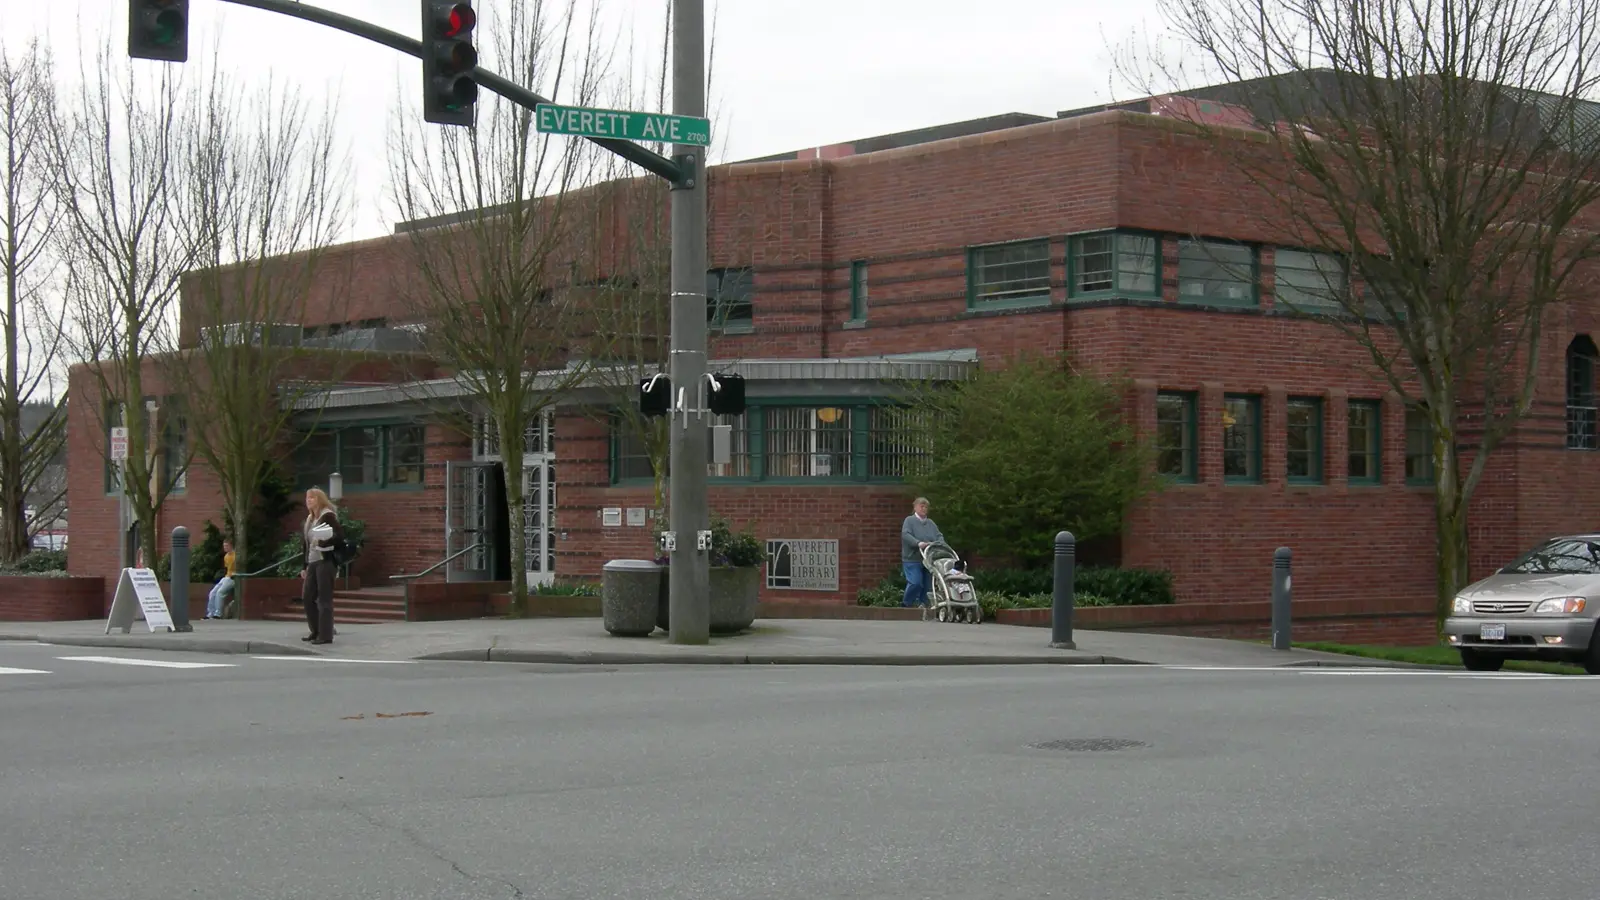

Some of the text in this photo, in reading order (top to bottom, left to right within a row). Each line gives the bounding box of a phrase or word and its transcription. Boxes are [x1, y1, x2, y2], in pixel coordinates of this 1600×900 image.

[540, 107, 707, 143] EVERETT AVE 2700
[792, 541, 836, 553] EVERETT
[792, 554, 836, 566] PUBLIC
[792, 567, 836, 579] LIBRARY
